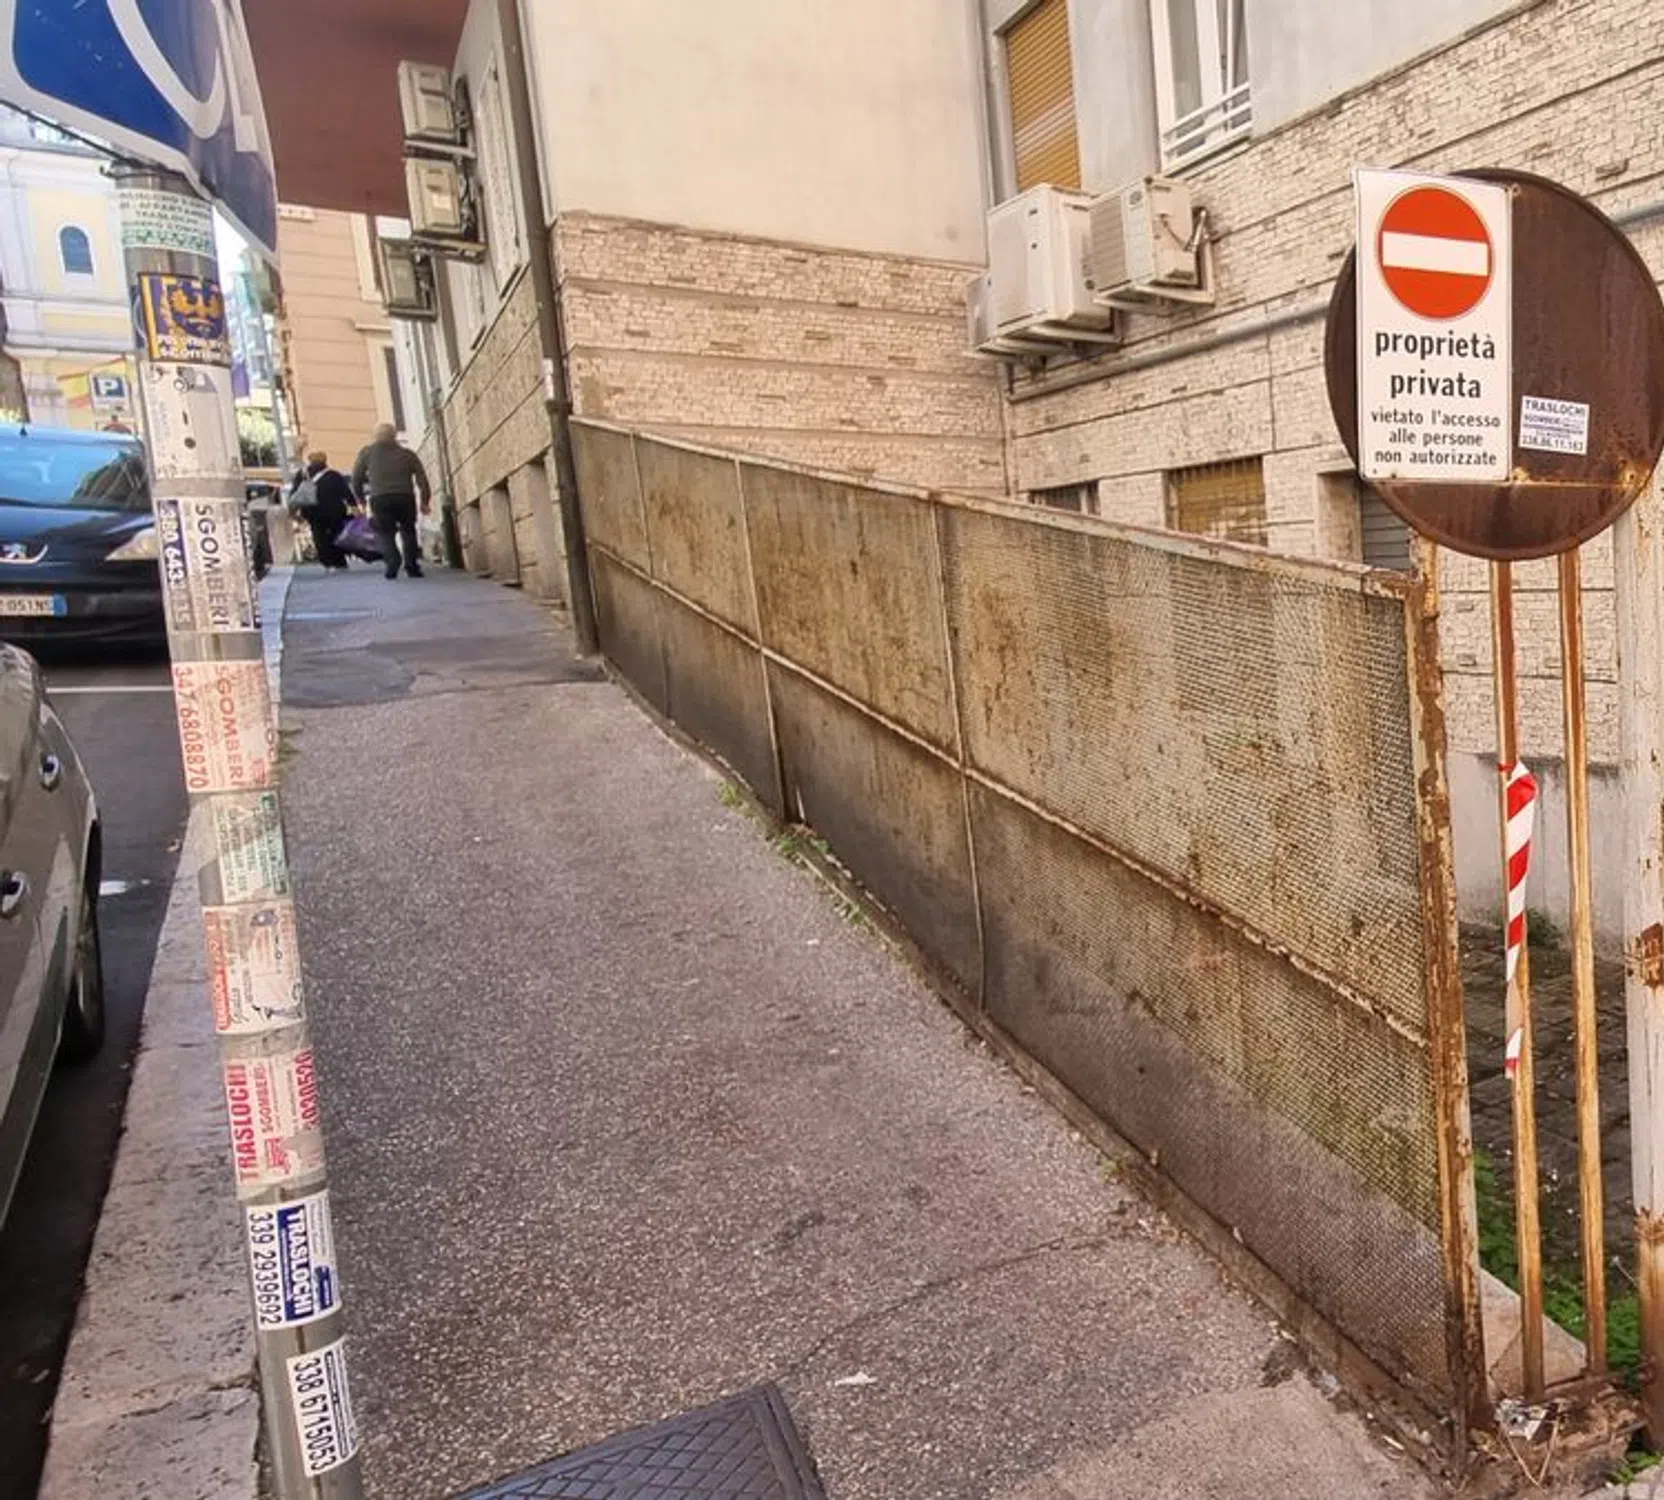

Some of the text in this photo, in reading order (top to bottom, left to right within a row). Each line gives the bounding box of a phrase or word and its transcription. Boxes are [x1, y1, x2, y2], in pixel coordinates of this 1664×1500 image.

[1375, 329, 1496, 361] proprietà
[98, 379, 119, 396] P
[1390, 368, 1482, 399] privata
[1371, 406, 1501, 428] vietato l'accesso
[1525, 399, 1586, 416] TRASLOCHI
[1389, 428, 1484, 448] alle persone
[1375, 449, 1498, 466] non autorizzate
[195, 503, 231, 627] SGOMBERI
[215, 663, 246, 788] SGOMBERI
[227, 1063, 259, 1184] TRASLOCHI
[250, 1212, 283, 1325] 339 2939692
[285, 1206, 314, 1315] TRASLOCHI
[293, 1357, 337, 1471] 338 6715053
